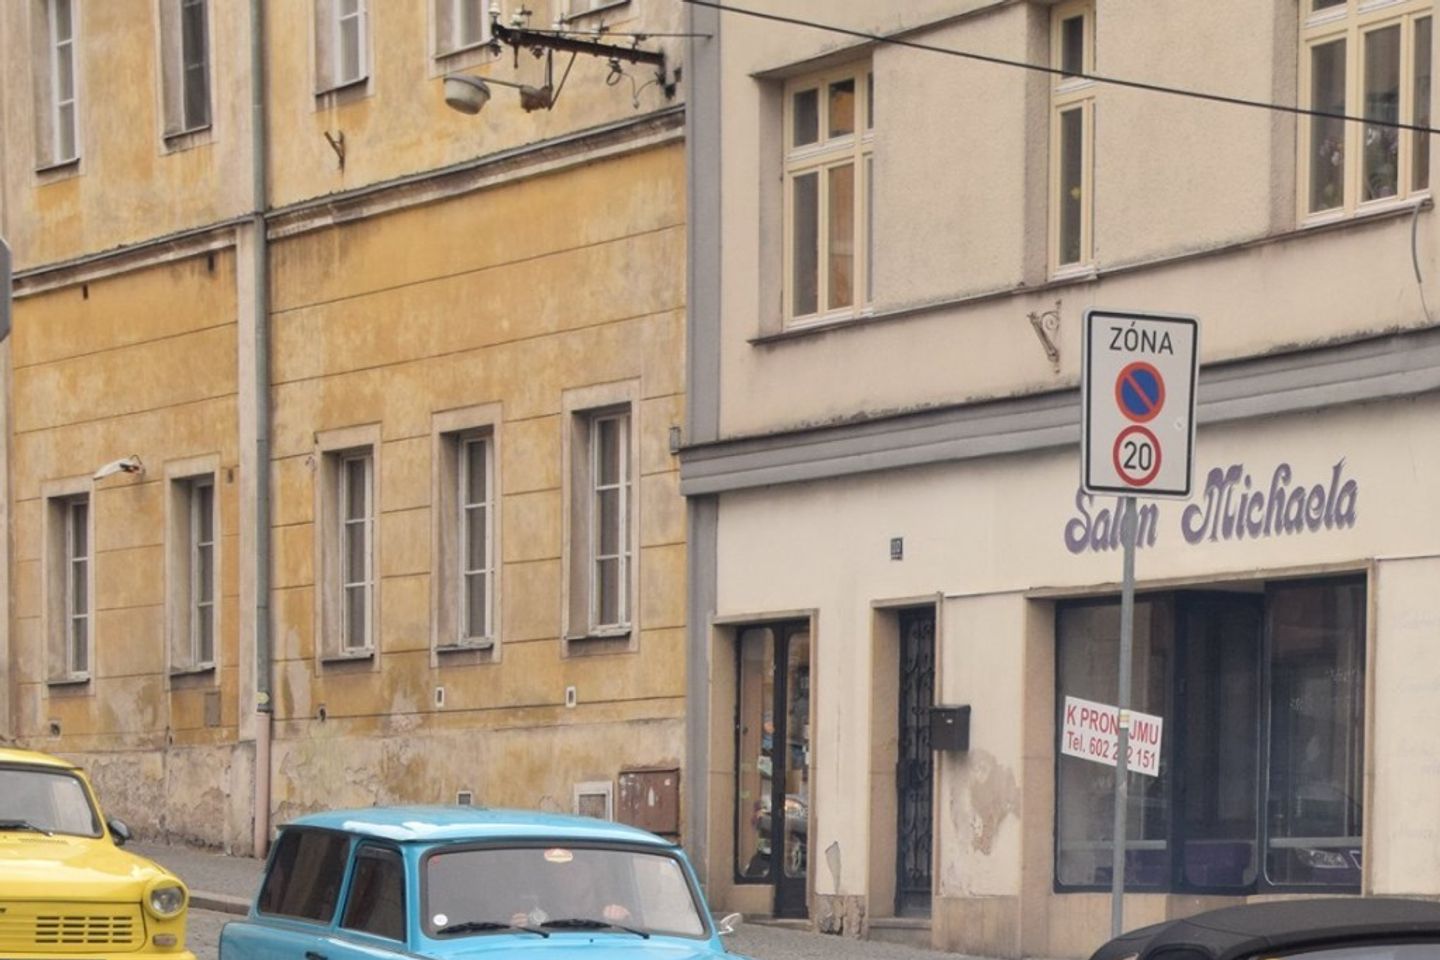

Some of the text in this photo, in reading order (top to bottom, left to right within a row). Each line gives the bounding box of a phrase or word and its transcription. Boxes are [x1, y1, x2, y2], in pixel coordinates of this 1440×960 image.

[1109, 321, 1174, 355] ZÓNA
[1123, 441, 1152, 471] 20
[1064, 456, 1358, 554] Saln Michaela
[1066, 705, 1159, 745] K PRONJMU
[1067, 731, 1155, 770] Tel. 602 22 151
